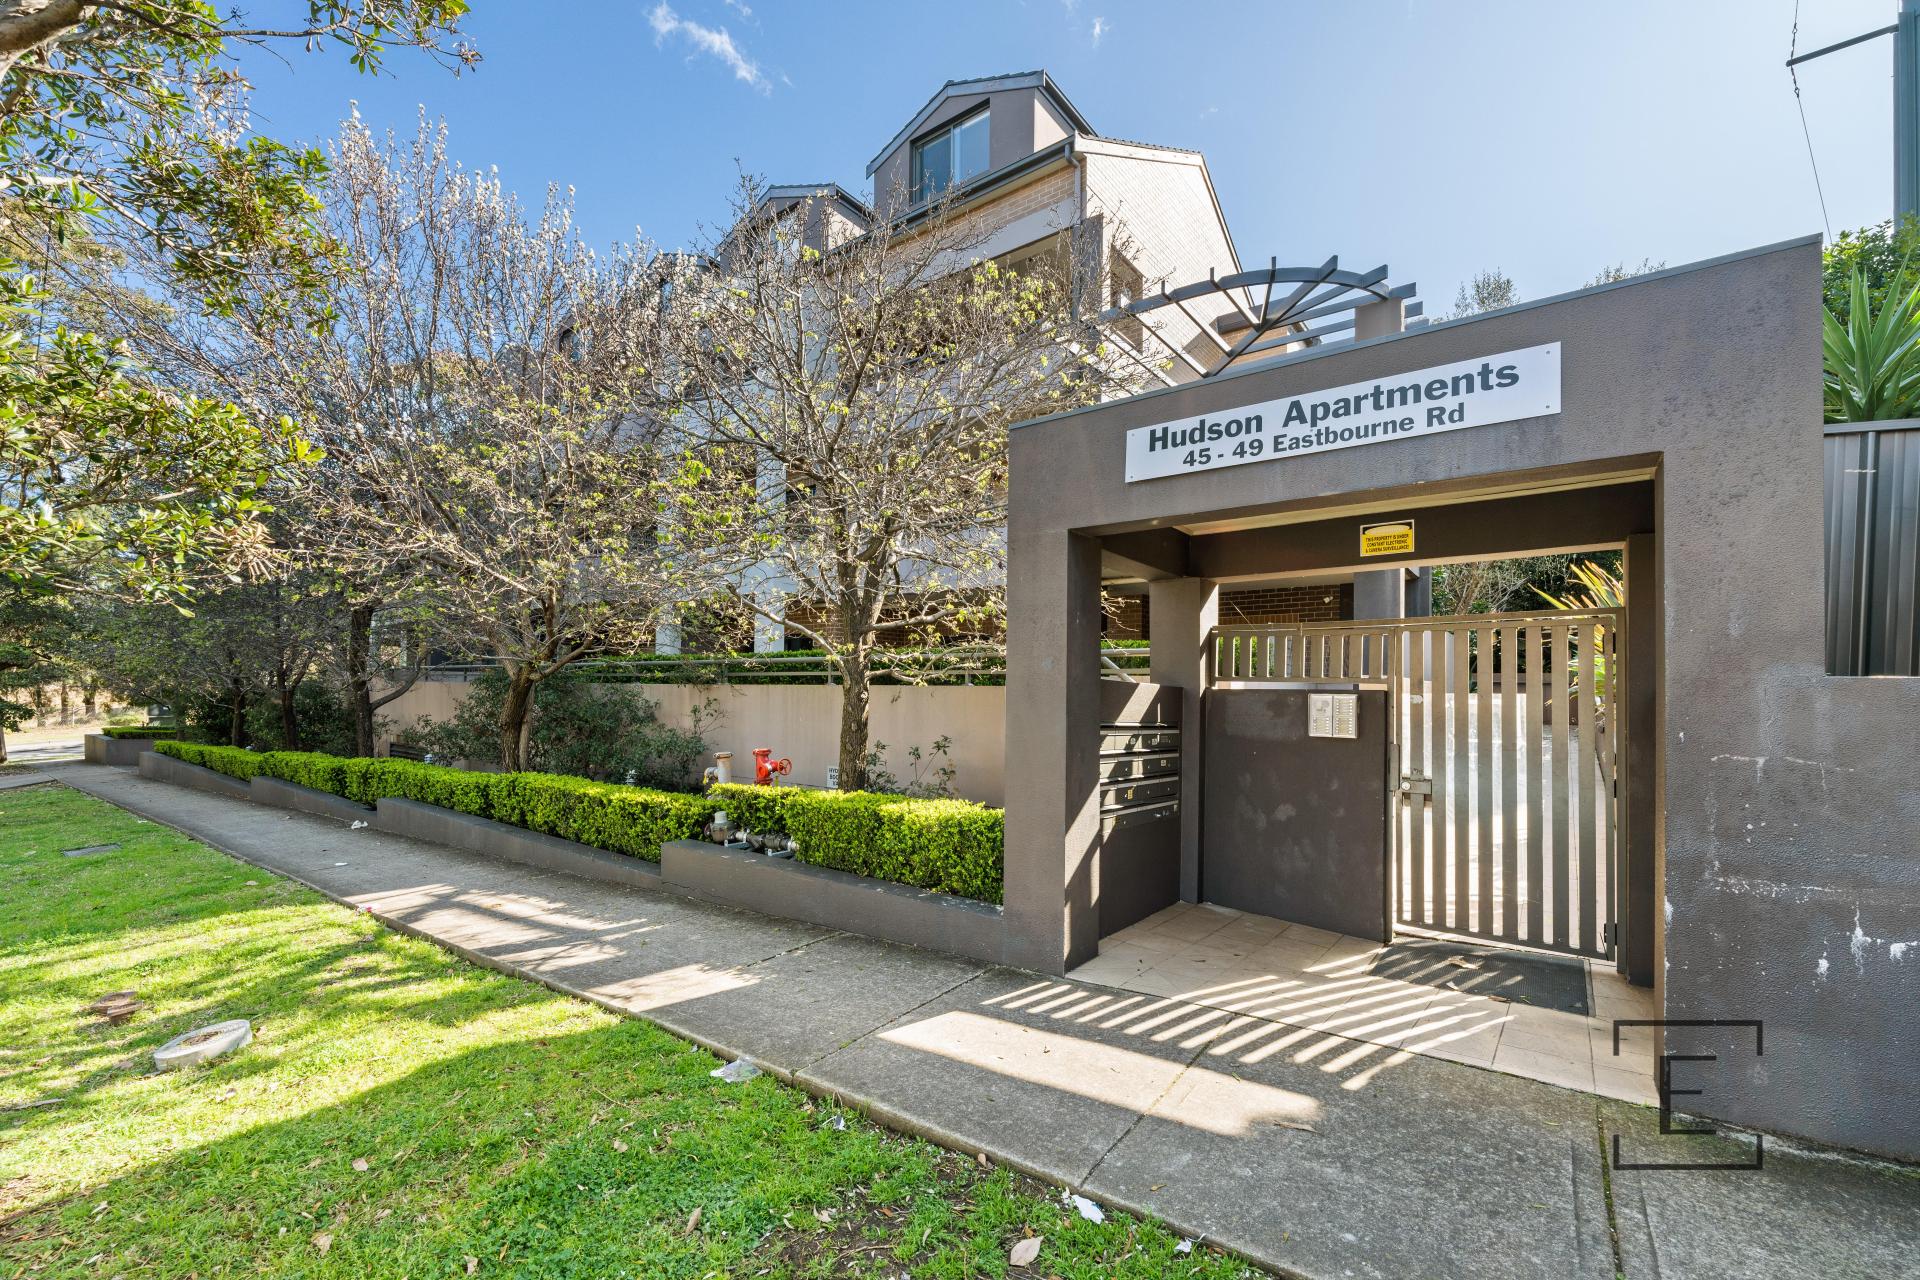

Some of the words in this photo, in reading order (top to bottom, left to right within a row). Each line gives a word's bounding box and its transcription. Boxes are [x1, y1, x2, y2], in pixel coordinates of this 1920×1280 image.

[1148, 411, 1263, 452] Hudson
[1282, 361, 1520, 428] Apartments
[1182, 447, 1213, 468] 45
[1232, 438, 1264, 460] 49
[1273, 413, 1415, 454] Eastbourne
[1426, 402, 1466, 428] Rd
